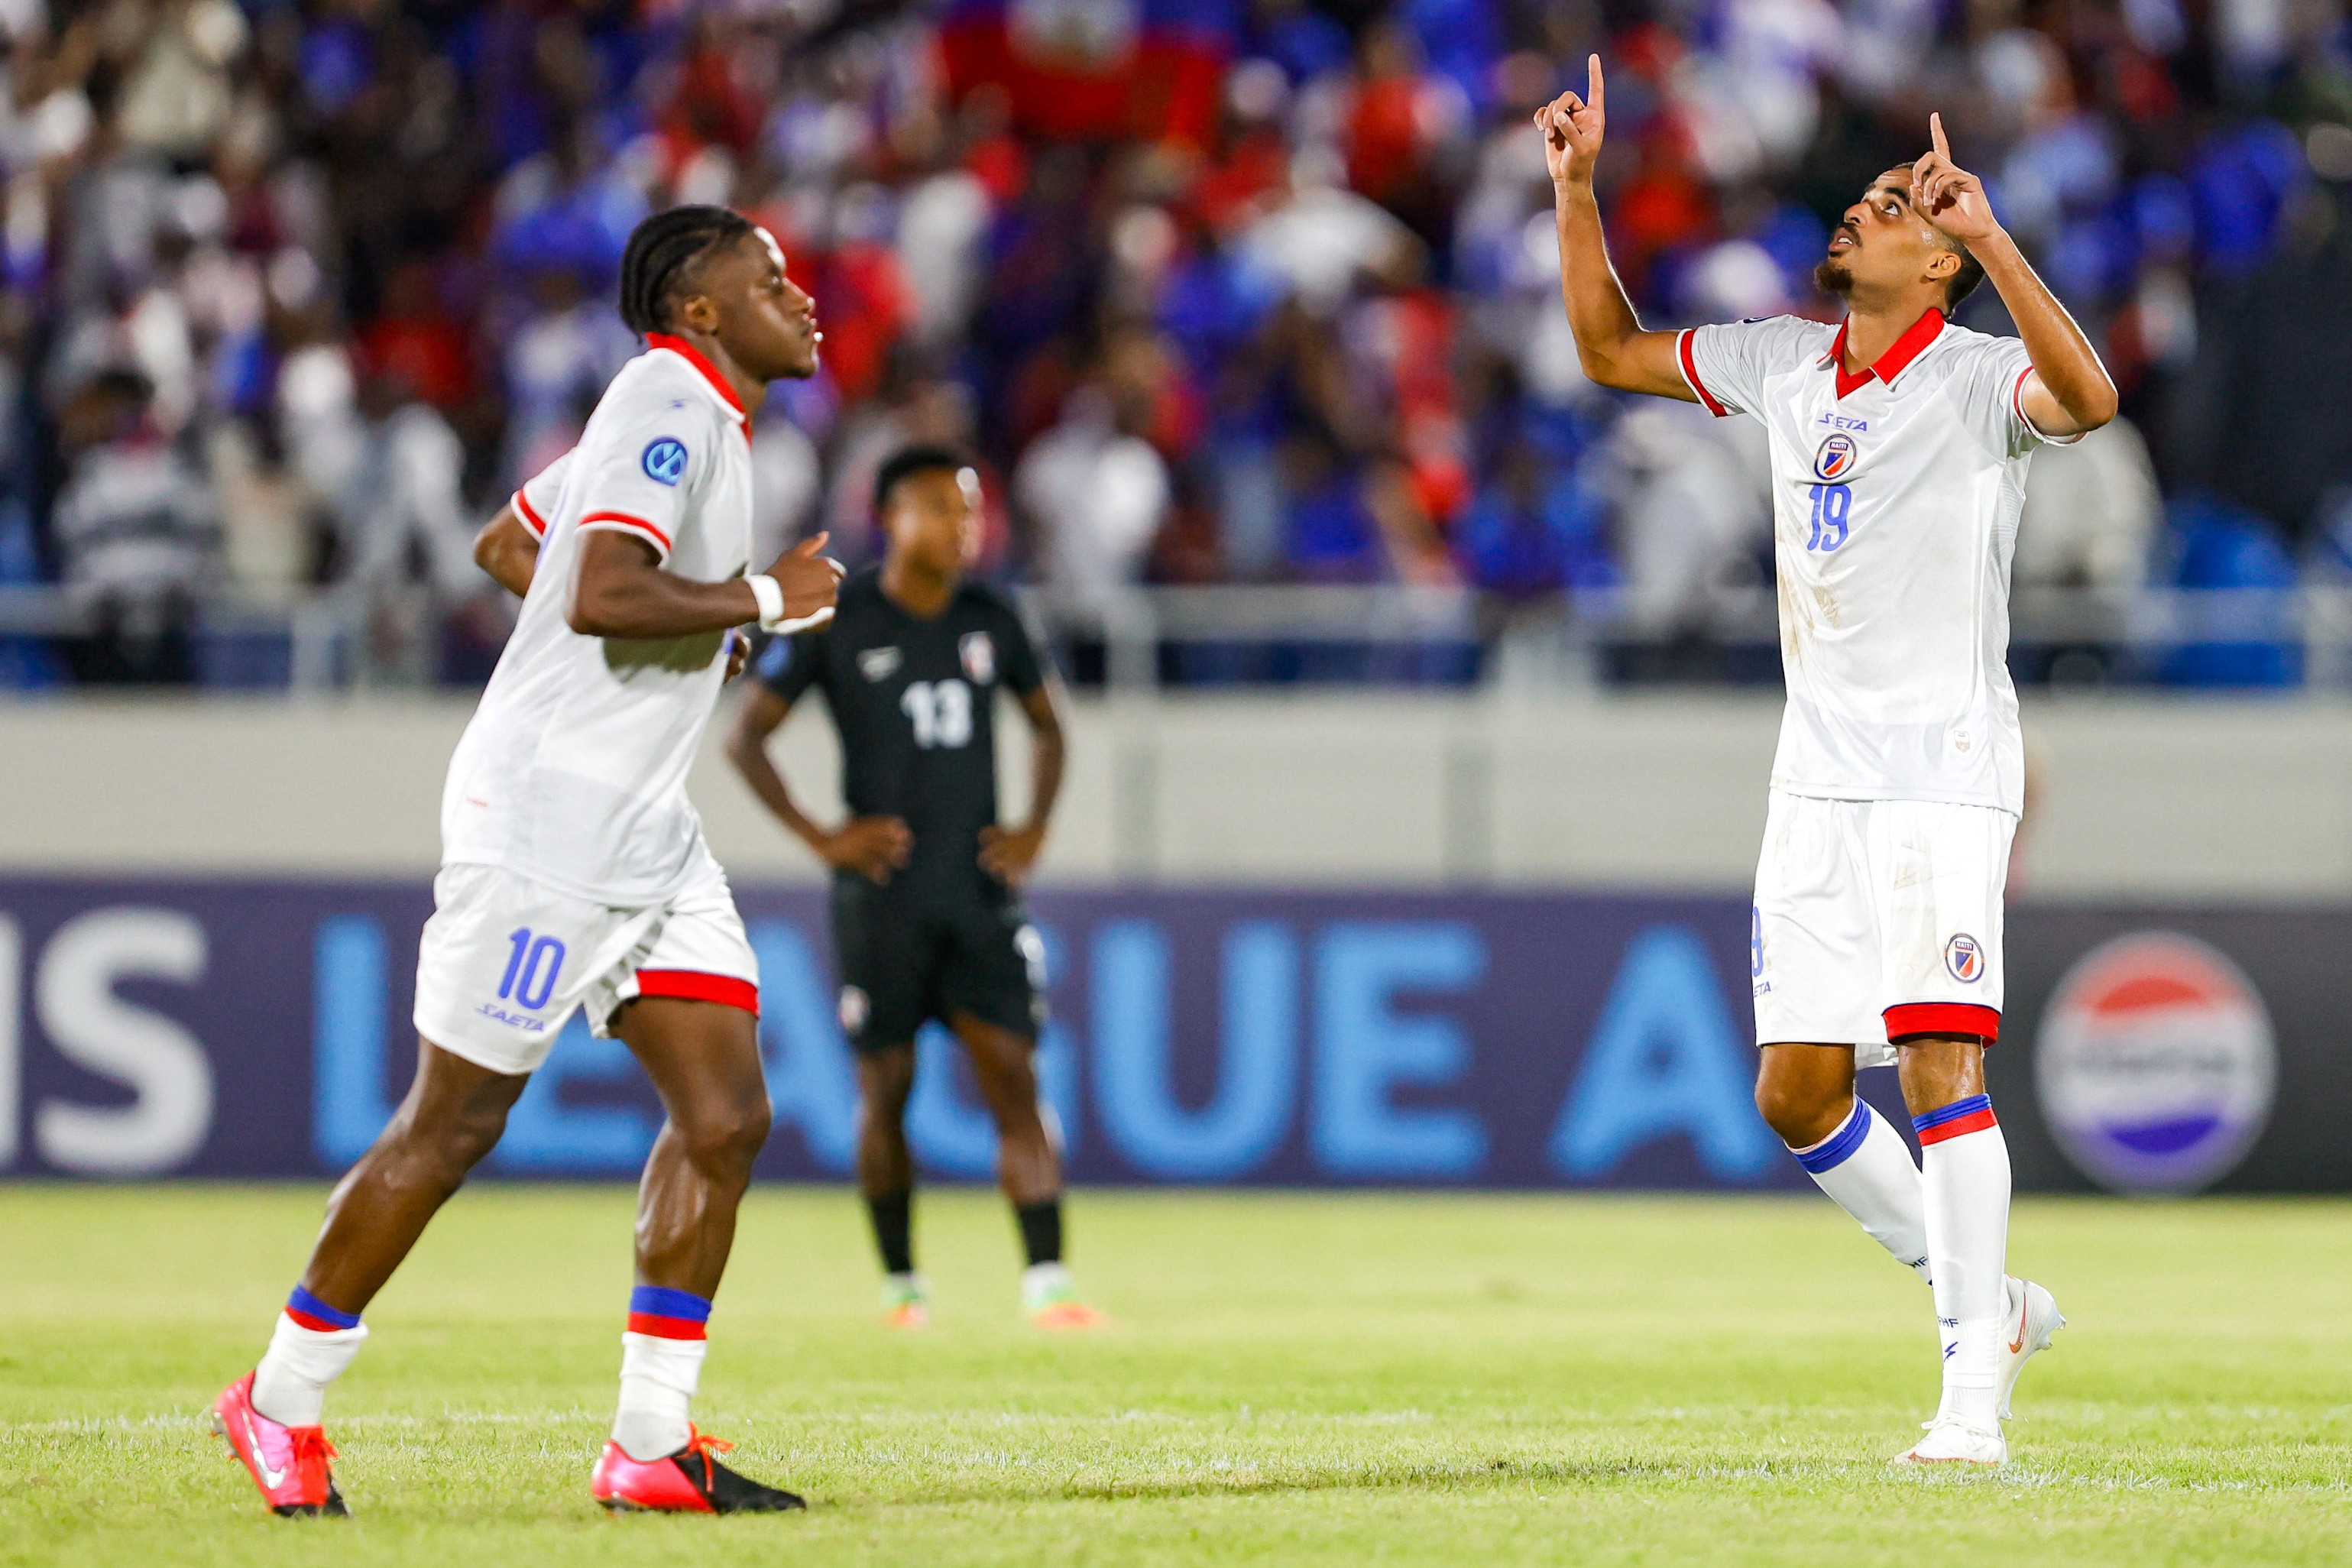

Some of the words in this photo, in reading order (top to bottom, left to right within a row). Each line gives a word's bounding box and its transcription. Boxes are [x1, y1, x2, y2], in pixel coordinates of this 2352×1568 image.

[1817, 413, 1867, 432] SETA
[1807, 482, 1851, 552] 19
[899, 678, 974, 749] 13
[498, 928, 565, 1009] 10
[1956, 941, 1973, 950] HAITI
[475, 1003, 545, 1031] SAETA
[1551, 921, 1777, 1181] A
